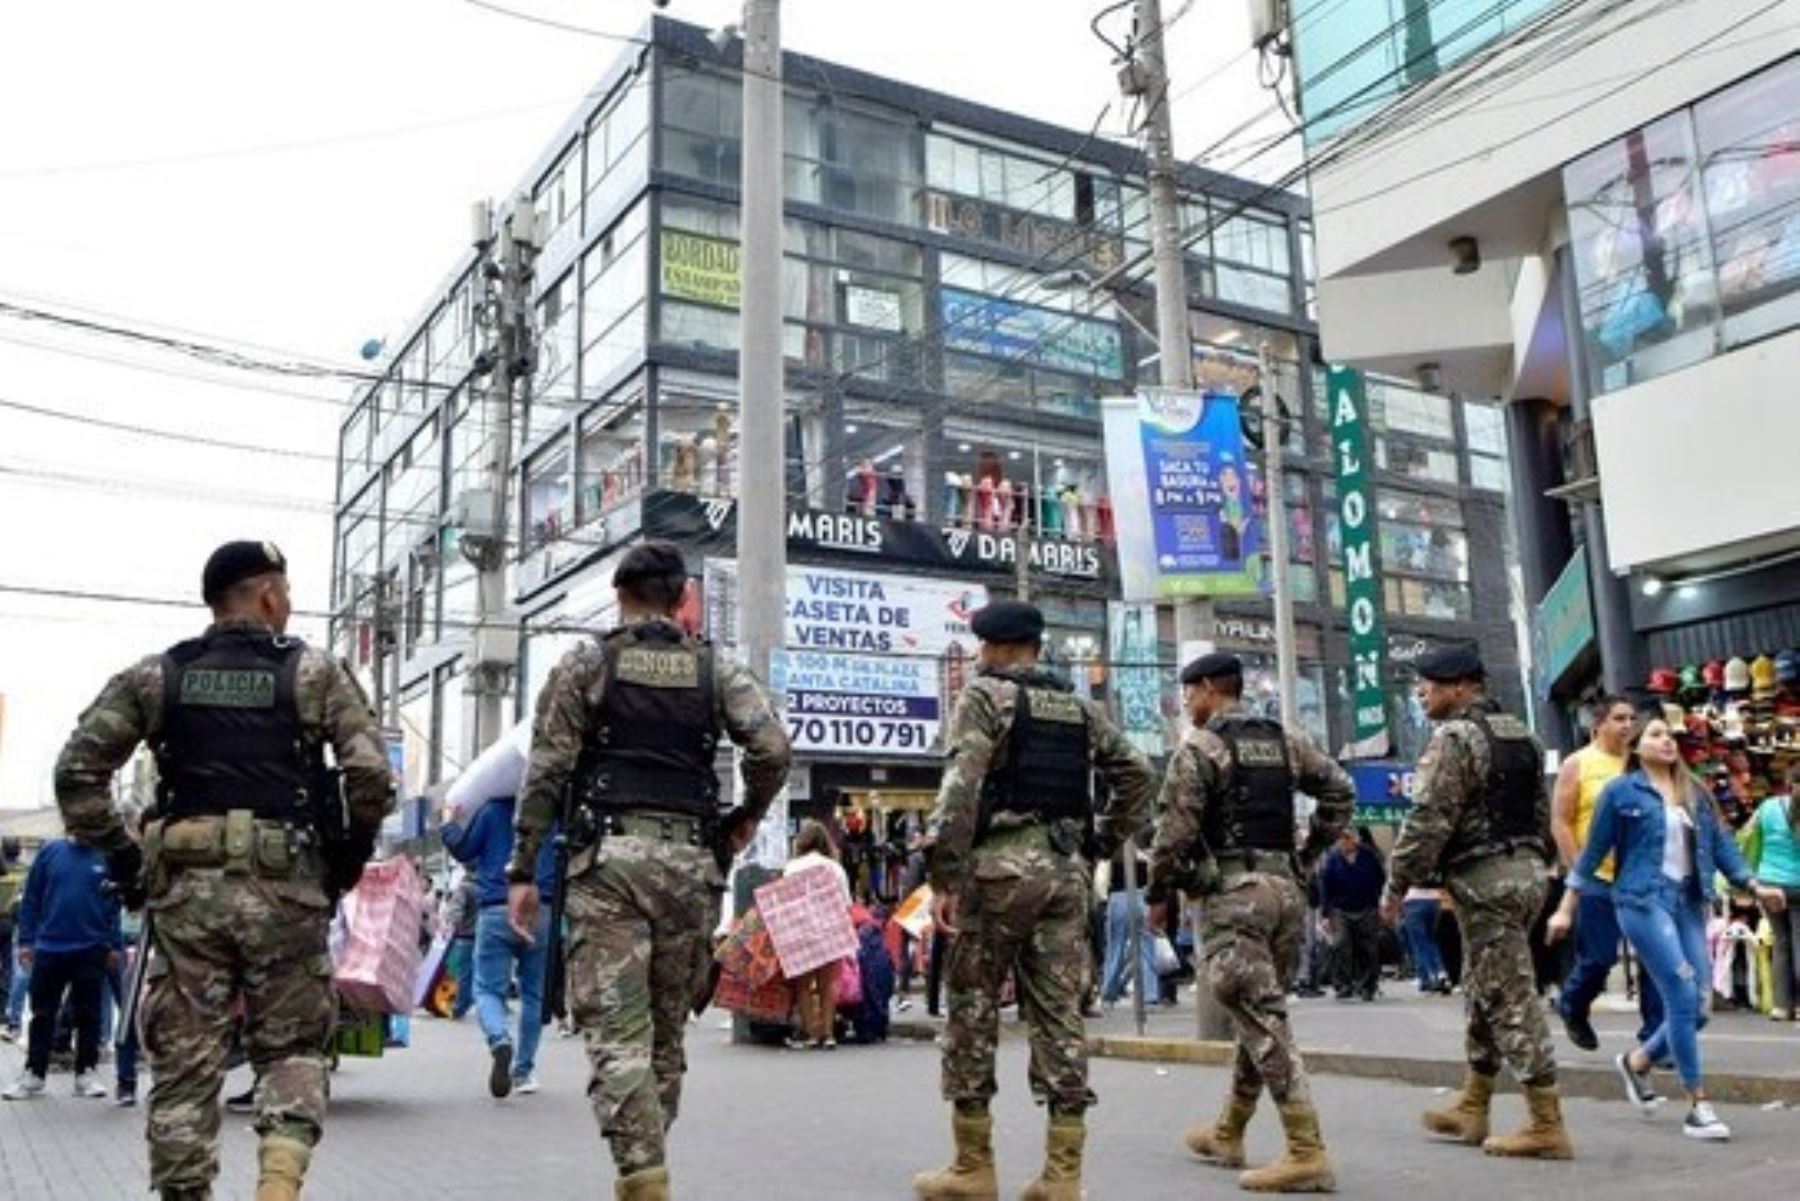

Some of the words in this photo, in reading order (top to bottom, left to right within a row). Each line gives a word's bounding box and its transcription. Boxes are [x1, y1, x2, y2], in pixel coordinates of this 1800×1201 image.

[1330, 361, 1379, 690] ALOMON
[805, 573, 886, 602] VISITA
[786, 600, 873, 624] ASETA
[878, 606, 910, 628] DE
[794, 626, 892, 652] VENTAS
[186, 672, 272, 692] POLICIA
[838, 675, 920, 695] CATALINA
[802, 693, 909, 715] PROYECTOS
